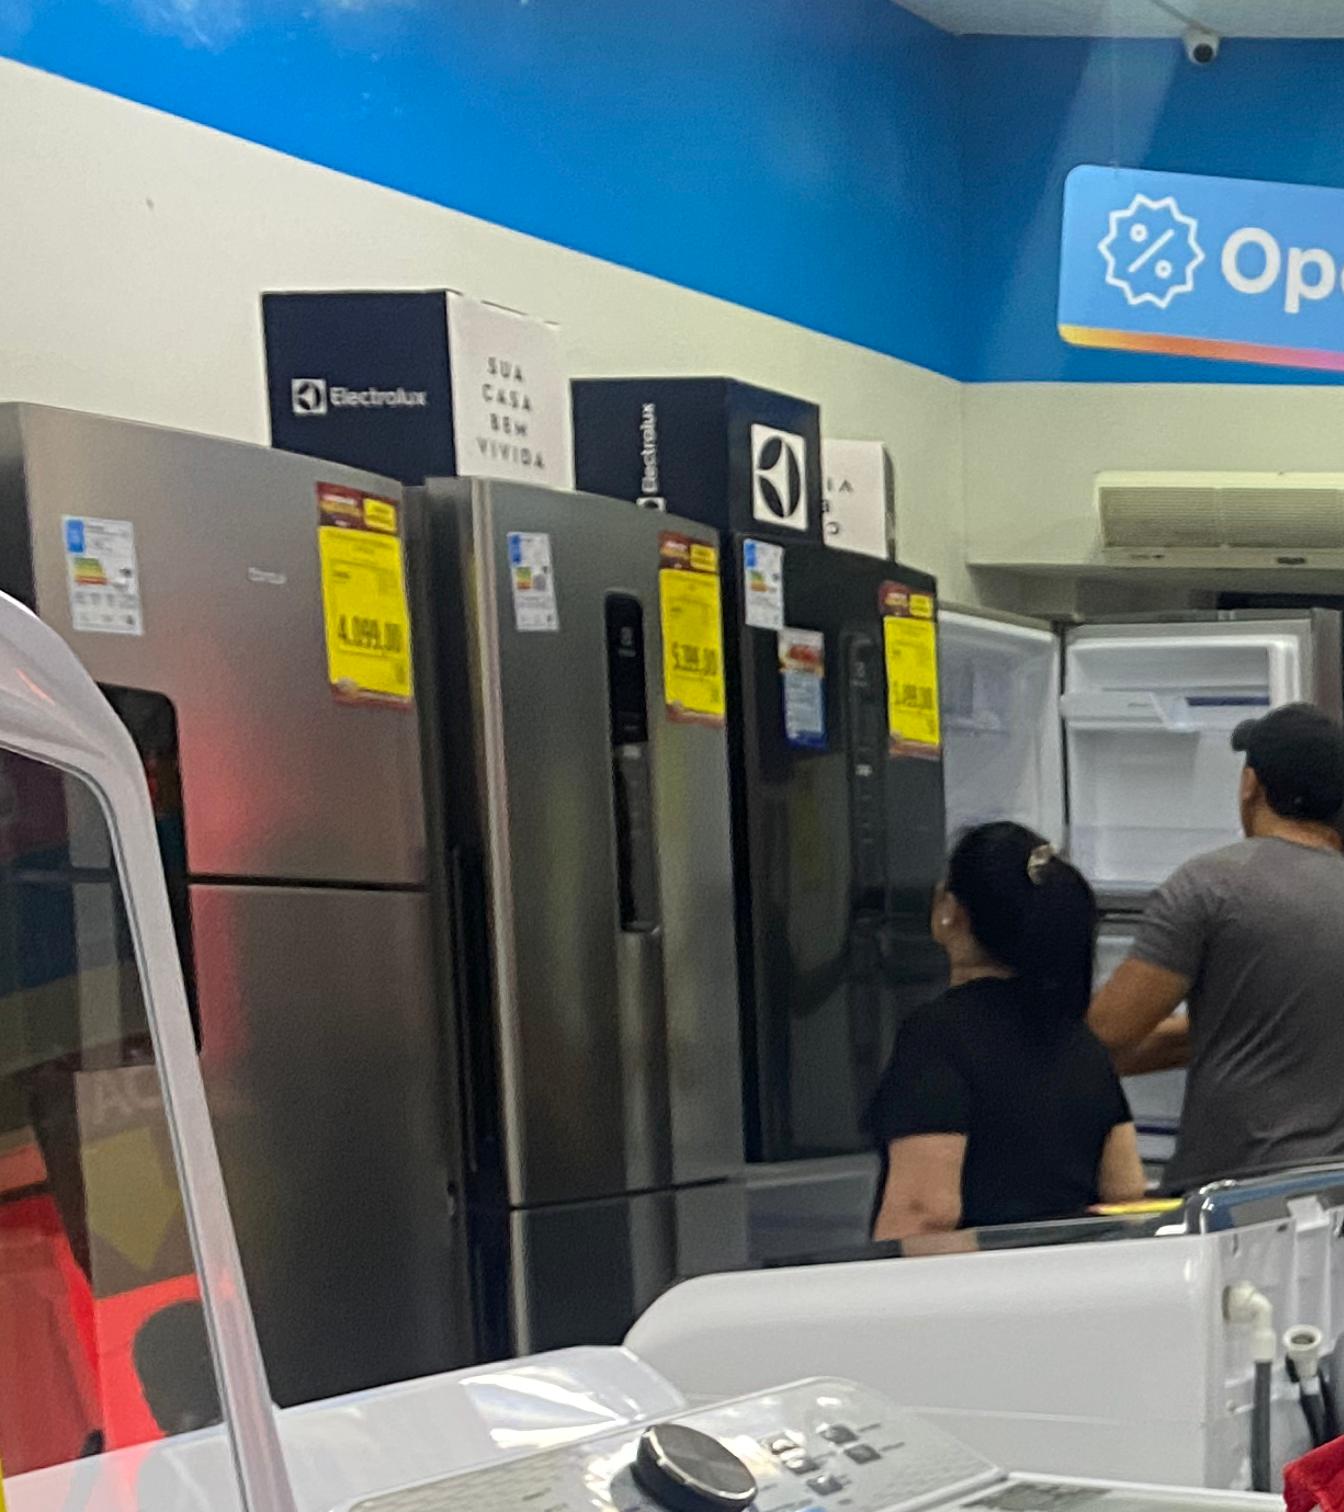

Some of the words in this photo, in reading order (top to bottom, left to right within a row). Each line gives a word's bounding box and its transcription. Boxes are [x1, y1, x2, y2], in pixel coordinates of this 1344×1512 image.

[487, 356, 524, 383] SUA
[329, 386, 428, 408] Electrolux
[481, 383, 533, 412] CASA
[489, 413, 528, 437] BEM
[476, 437, 545, 470] VIVIDA
